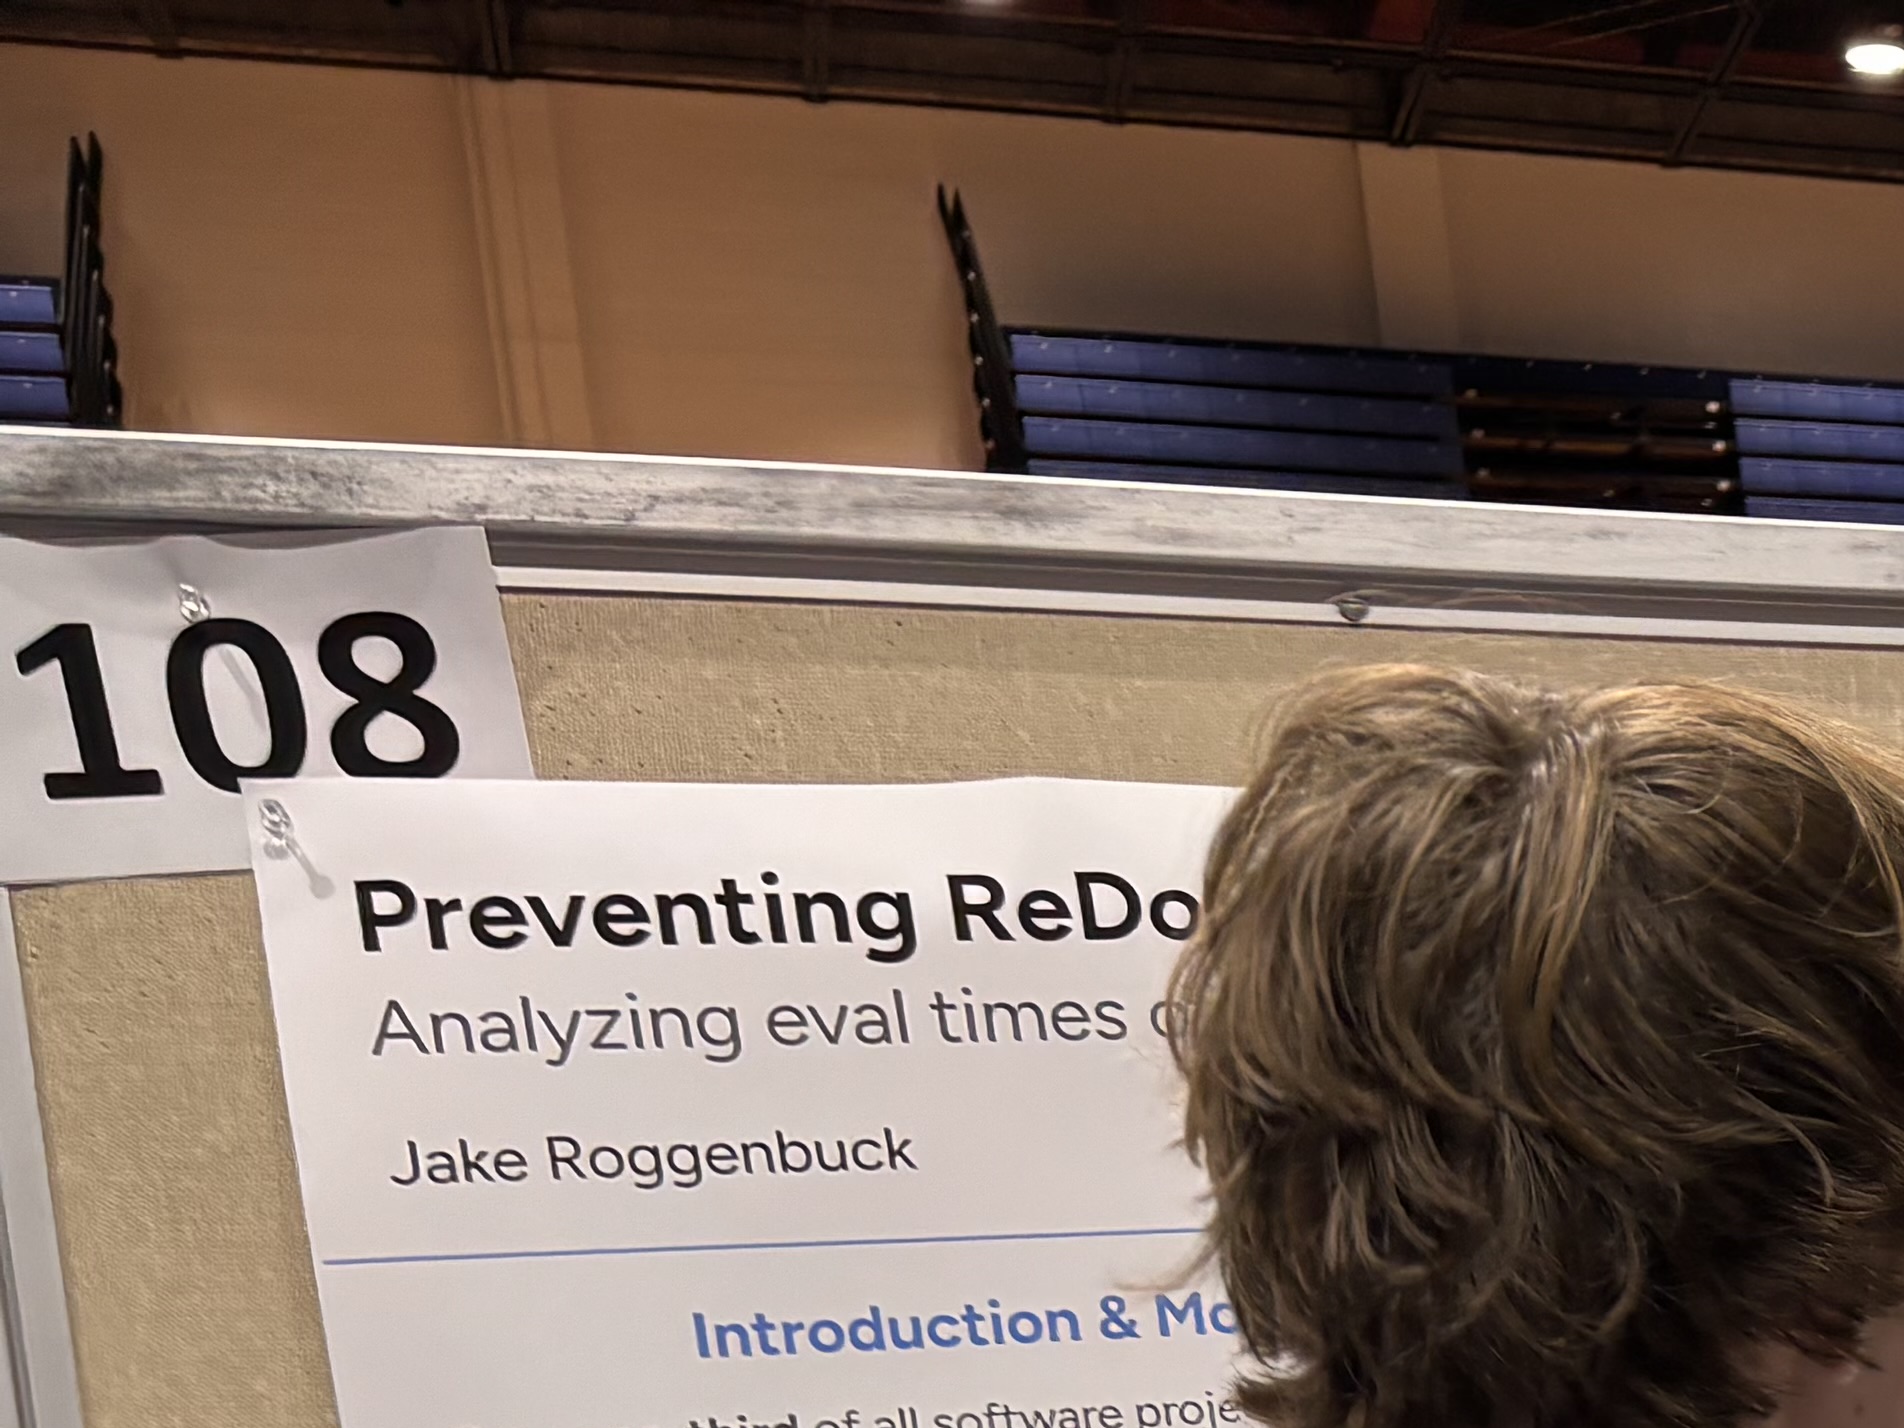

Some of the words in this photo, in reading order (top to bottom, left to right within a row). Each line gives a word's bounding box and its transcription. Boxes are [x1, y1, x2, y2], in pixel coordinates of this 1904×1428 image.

[15, 610, 462, 800] 108
[353, 871, 919, 961] Preventing
[371, 991, 744, 1066] Analyzing
[766, 988, 912, 1051] eval
[931, 985, 1129, 1047] times
[389, 1134, 529, 1186] Jake
[548, 1127, 919, 1184] Roggenbuck
[692, 1296, 1083, 1361] Introduction
[1099, 1292, 1142, 1342] &
